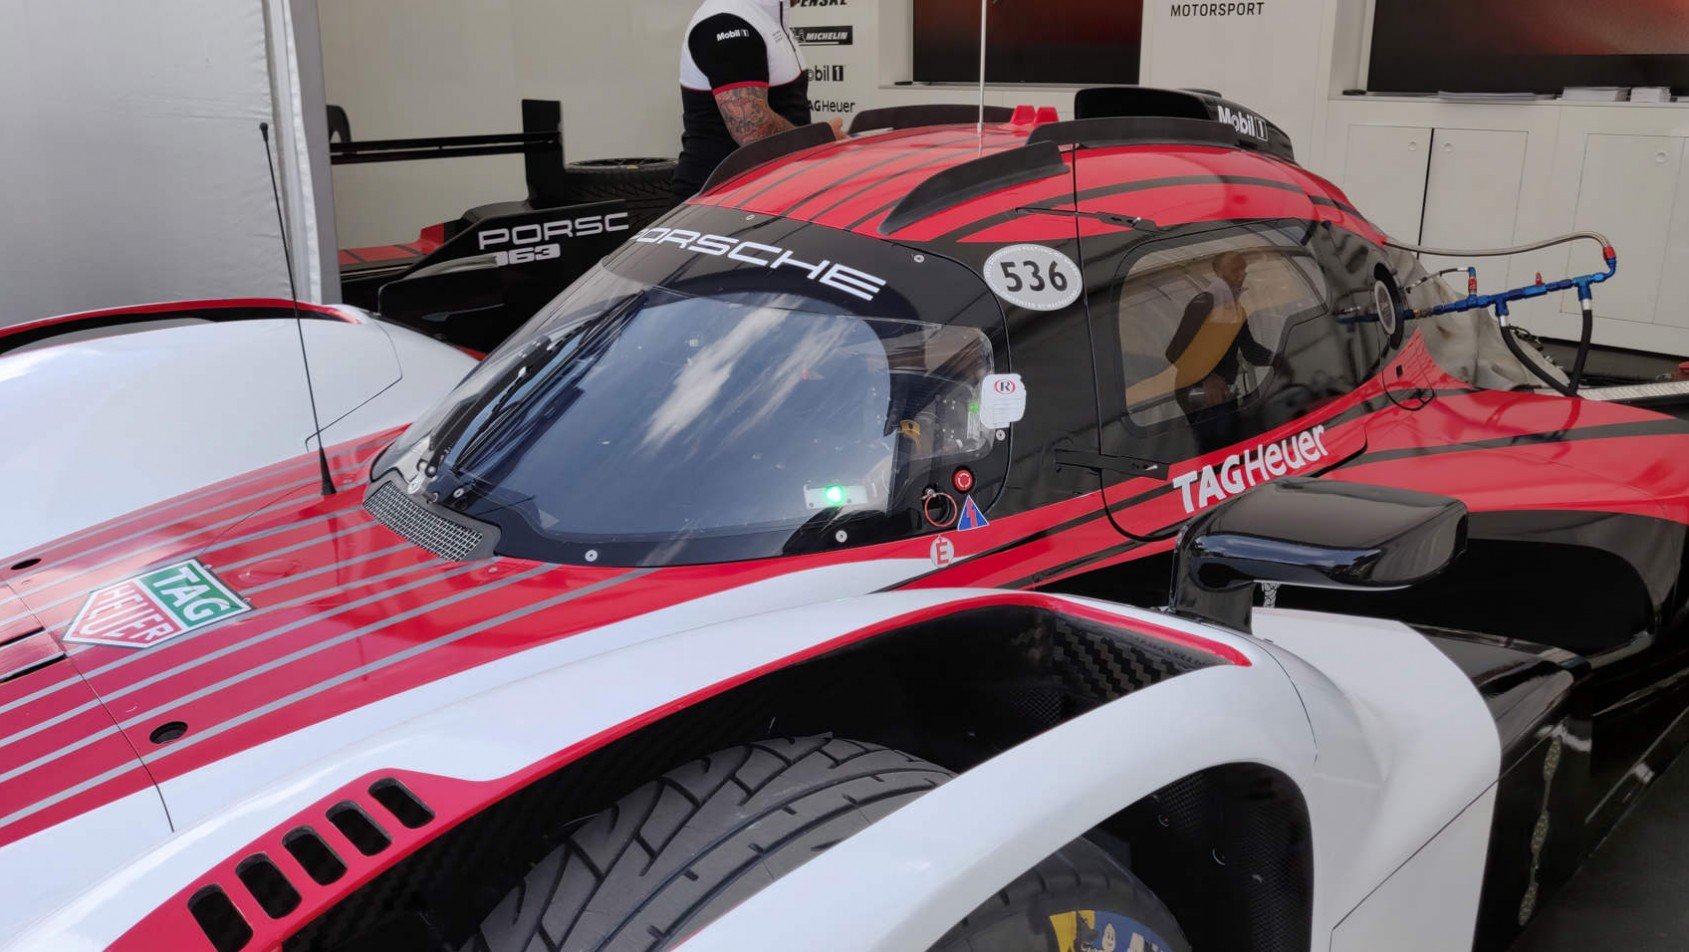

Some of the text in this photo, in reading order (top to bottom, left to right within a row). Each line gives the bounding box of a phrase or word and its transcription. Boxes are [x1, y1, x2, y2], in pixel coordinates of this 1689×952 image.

[1170, 2, 1264, 17] MOTORSPORT
[716, 29, 740, 41] Mobil
[806, 32, 848, 40] MICHELIN
[807, 100, 856, 112] AGHeuer
[1217, 105, 1255, 137] Mobil
[630, 227, 887, 301] ORSCHE
[1000, 260, 1068, 292] 536
[153, 566, 232, 622] TAG
[79, 584, 175, 641] HEUER
